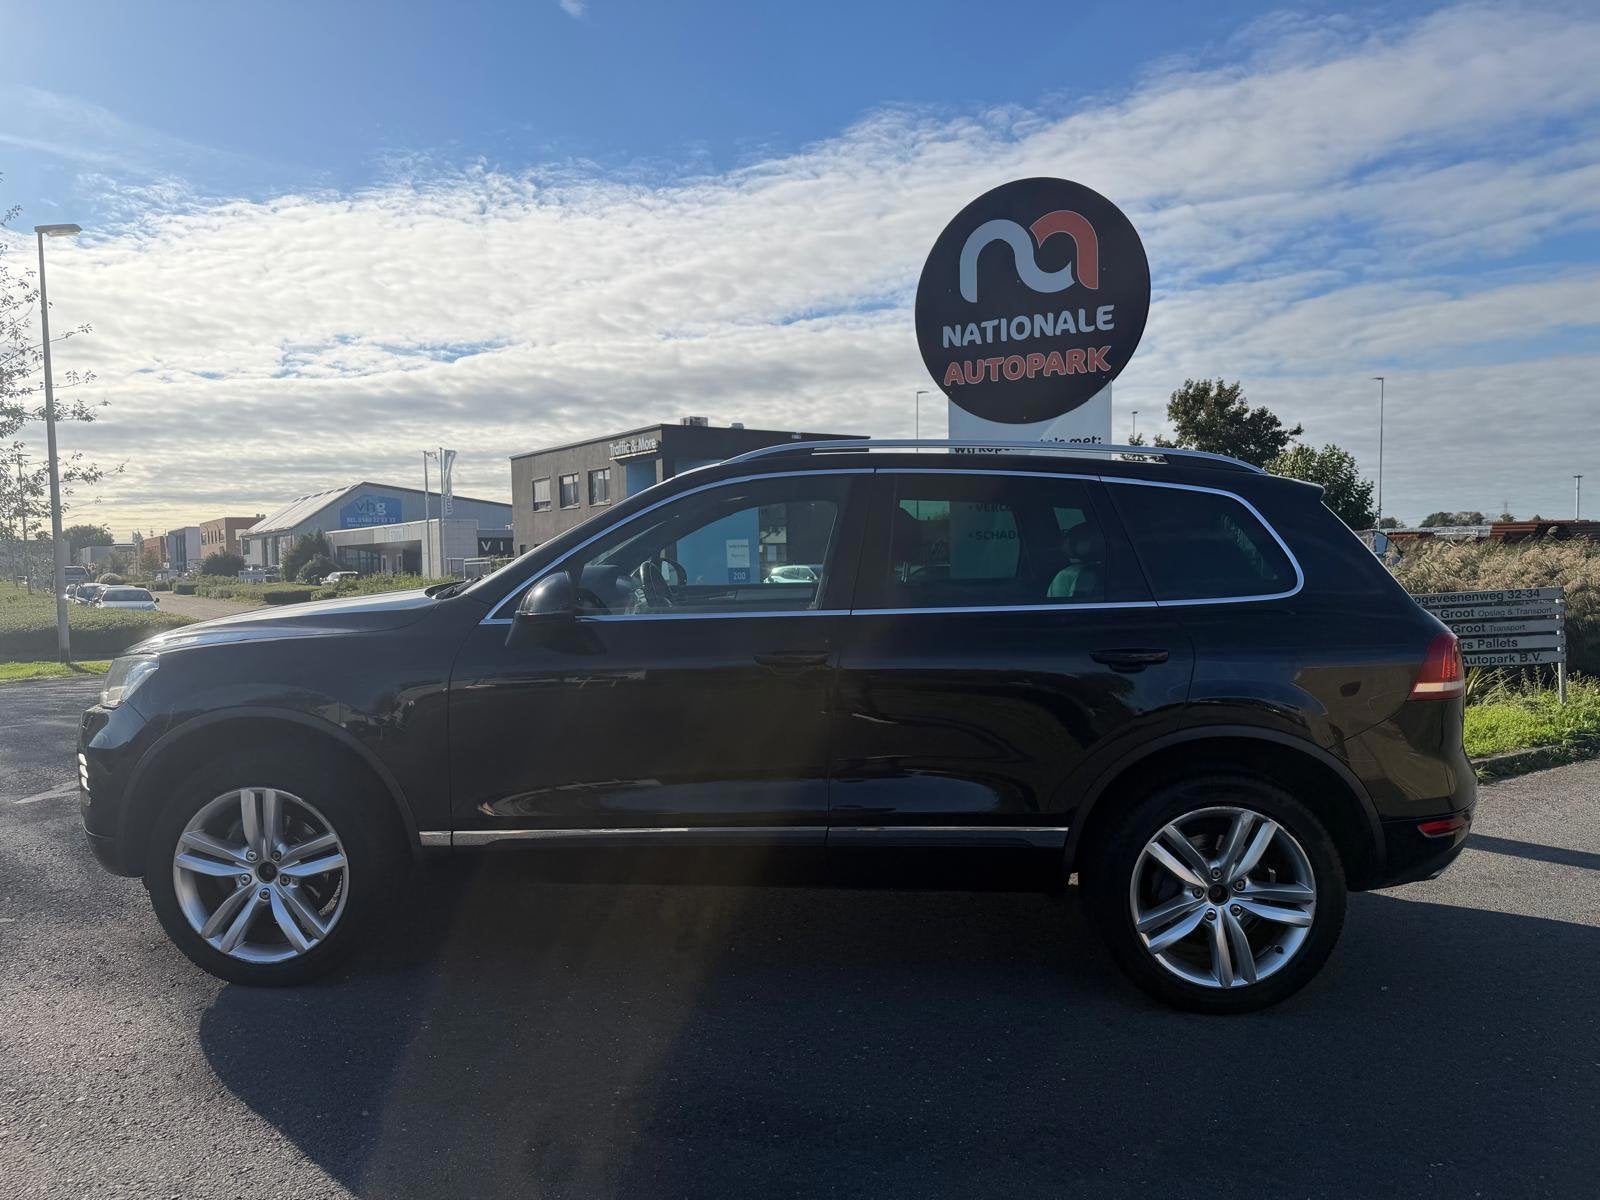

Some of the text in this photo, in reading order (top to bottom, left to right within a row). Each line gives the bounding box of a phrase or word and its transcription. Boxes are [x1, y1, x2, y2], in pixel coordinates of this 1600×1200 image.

[942, 304, 1115, 348] NATIONALE
[943, 345, 1112, 386] AUTOPARK
[638, 435, 657, 451] More
[976, 530, 1016, 540] SCHAD
[1414, 589, 1540, 606] ogeveenenweg 32-34
[1440, 608, 1474, 618] Groot
[1516, 606, 1552, 616] Transport
[1451, 623, 1526, 633] Groot Transport
[1461, 638, 1518, 650] rs Pallets
[1463, 652, 1543, 666] Autopark B.V.
